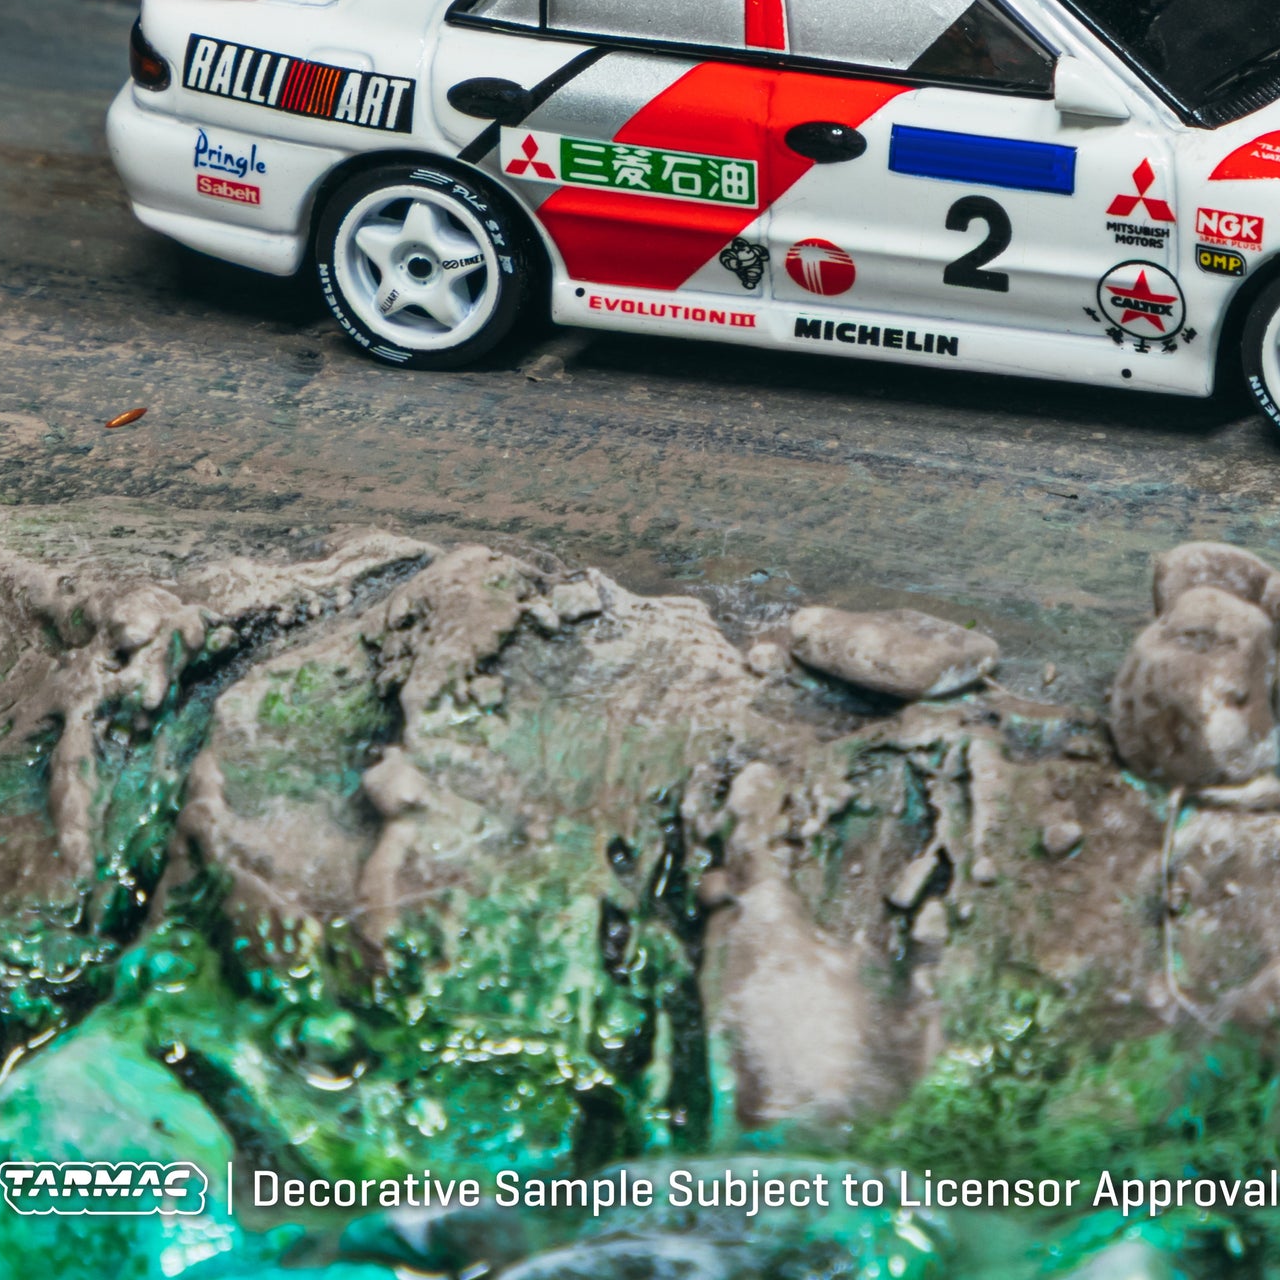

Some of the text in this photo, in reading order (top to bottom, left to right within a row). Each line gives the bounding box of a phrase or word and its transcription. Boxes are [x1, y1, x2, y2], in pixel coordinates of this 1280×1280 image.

[194, 127, 267, 178] Pringle
[569, 143, 750, 201] 三菱石油
[199, 178, 259, 204] Sabelt
[1114, 234, 1165, 249] MOTORS
[1198, 210, 1259, 241] NGK
[943, 194, 1012, 293] 2
[1200, 252, 1242, 271] OMP
[319, 263, 370, 348] MICHELIN
[379, 288, 400, 314] ALLIART
[589, 295, 756, 328] EVOLUTION III
[794, 317, 960, 357] MICHELIN
